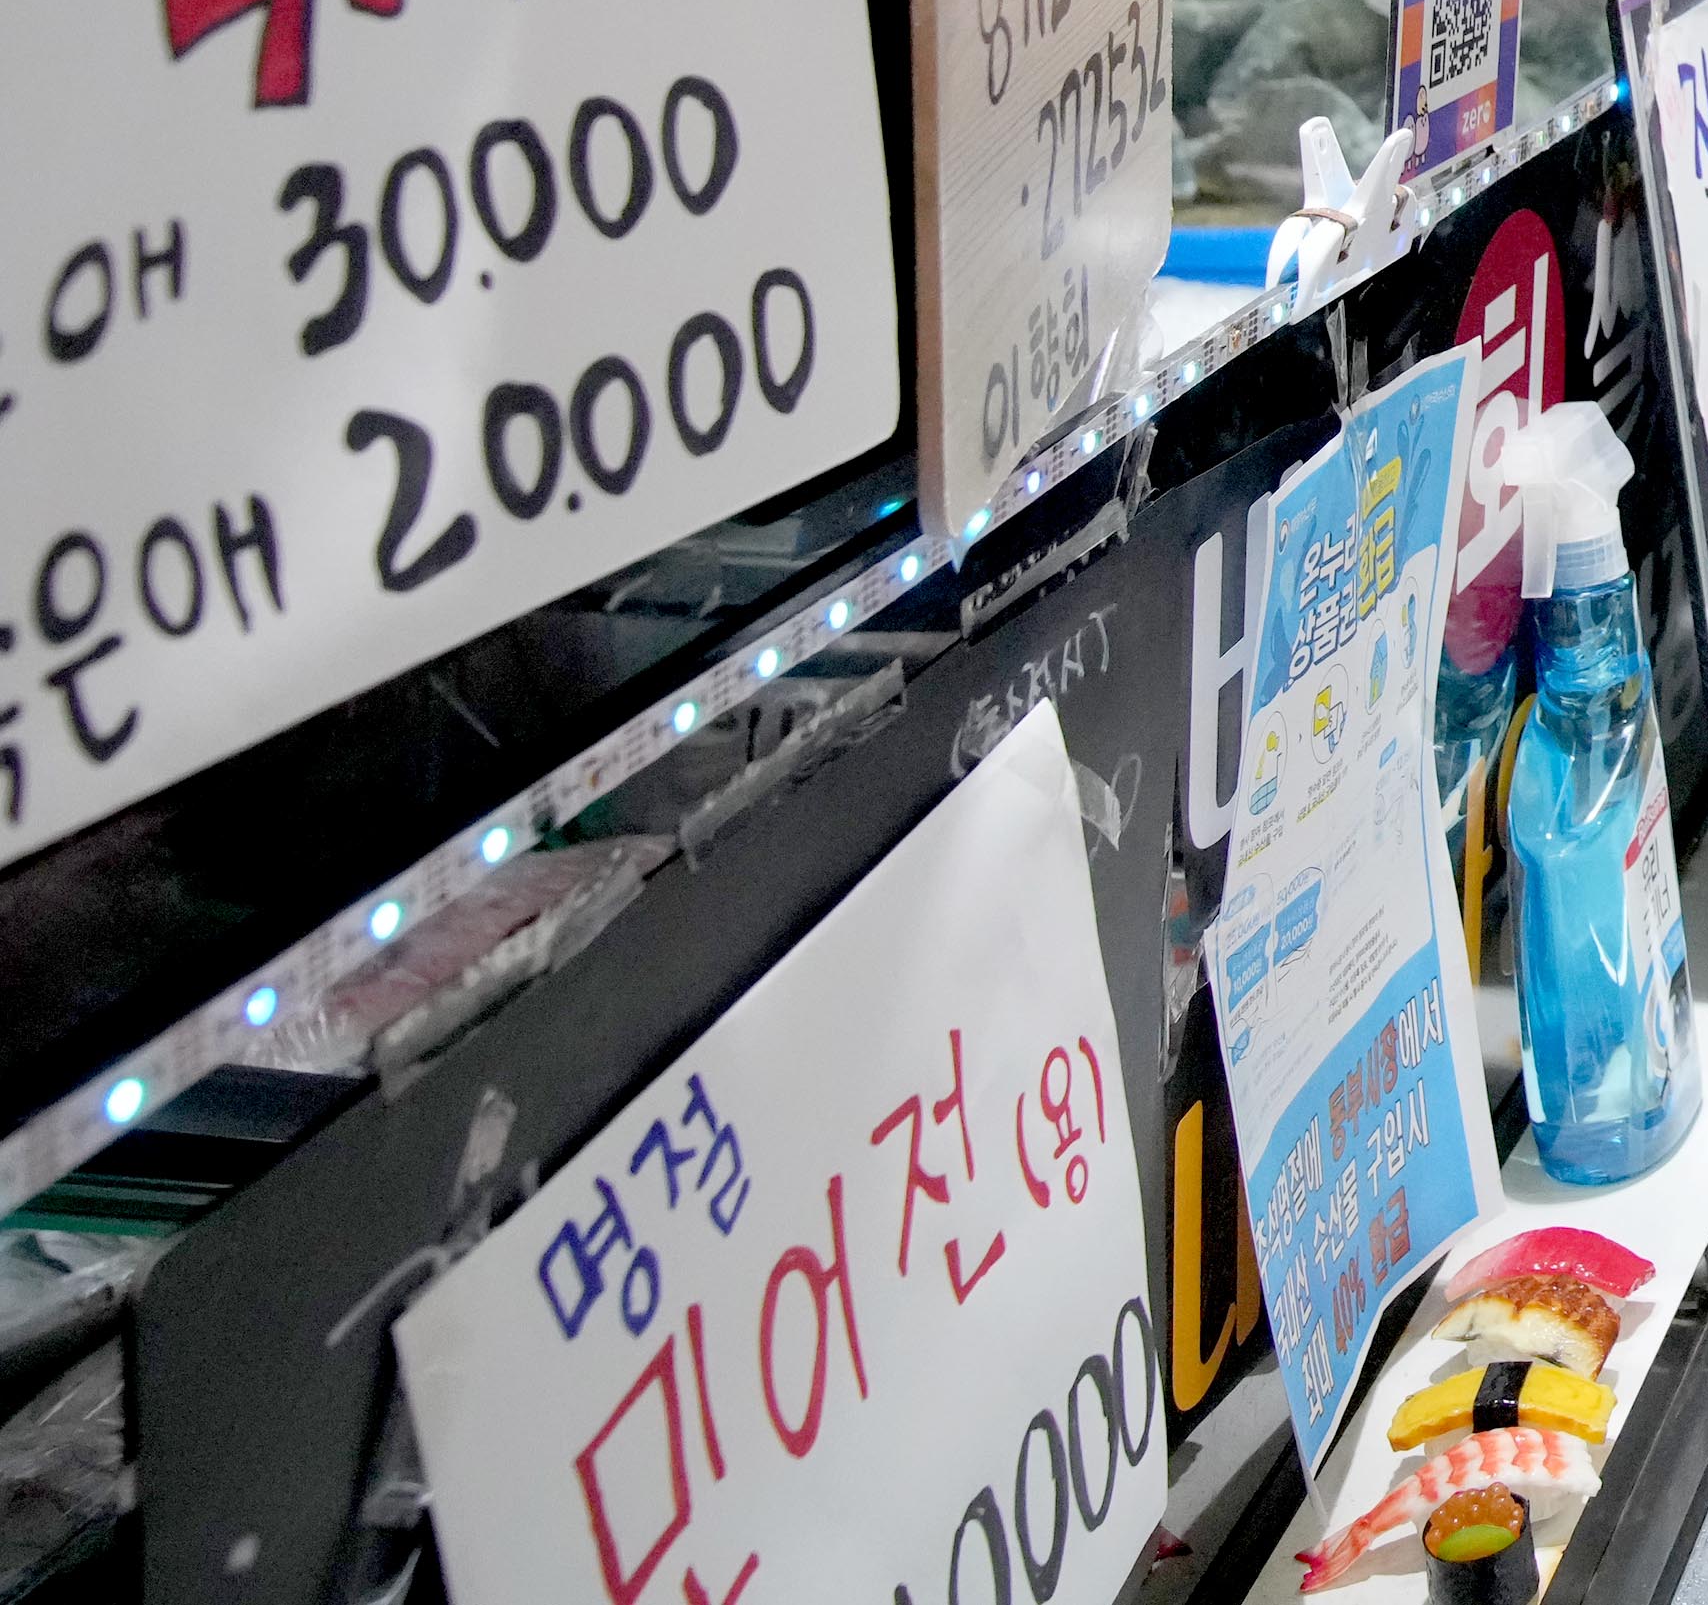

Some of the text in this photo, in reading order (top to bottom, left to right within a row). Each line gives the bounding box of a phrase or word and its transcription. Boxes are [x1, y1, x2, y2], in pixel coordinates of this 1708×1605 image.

[1299, 511, 1359, 613] 온누리
[1286, 578, 1359, 685] 상품권
[536, 1071, 753, 1341] 명절
[1313, 1157, 1360, 1283] 수산물
[894, 1295, 1157, 1605] 0000
